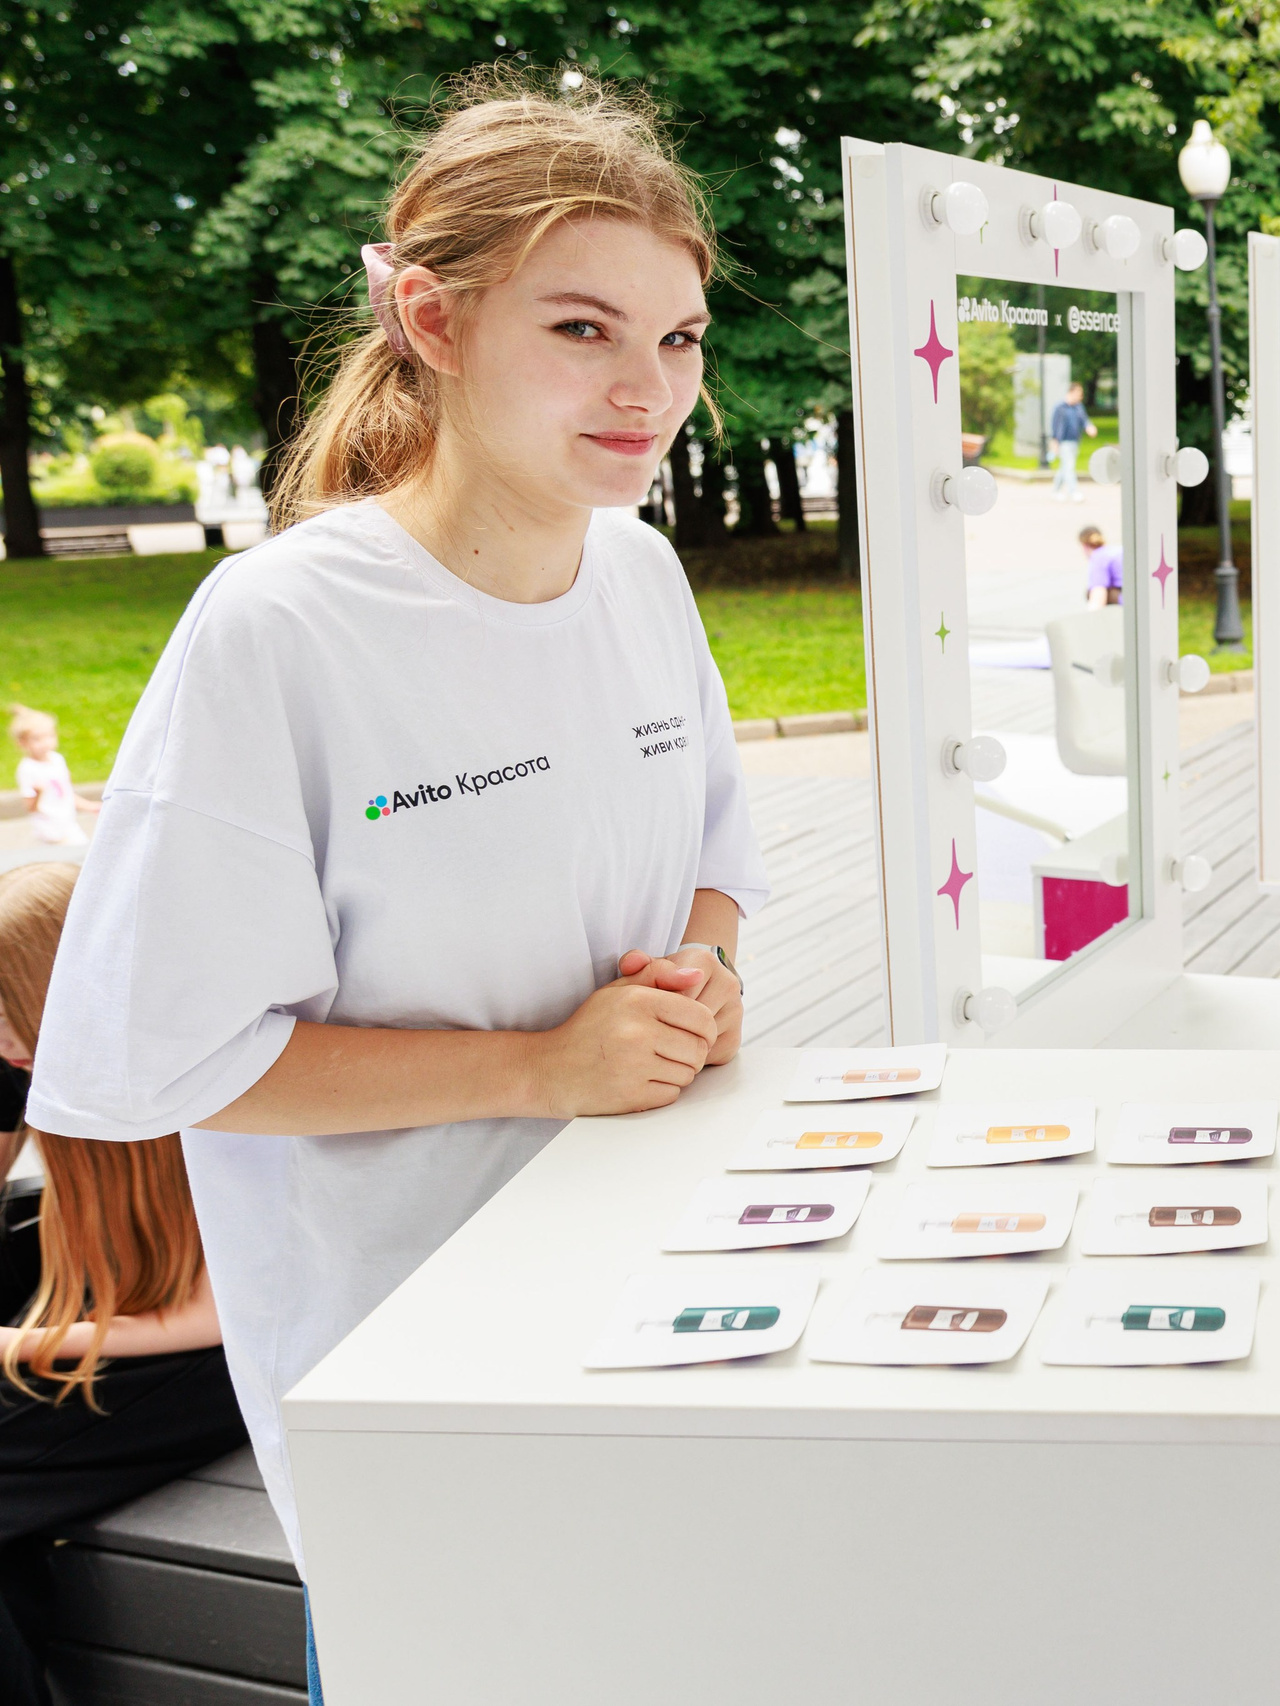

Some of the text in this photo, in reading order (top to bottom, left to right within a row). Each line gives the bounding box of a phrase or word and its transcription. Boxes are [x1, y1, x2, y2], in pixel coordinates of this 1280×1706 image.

[971, 297, 999, 322] Avito
[1001, 300, 1048, 329] Красота
[1068, 305, 1121, 333] essence
[632, 720, 670, 738] жизнь
[640, 740, 674, 758] живи
[393, 755, 551, 813] Avito Красота
